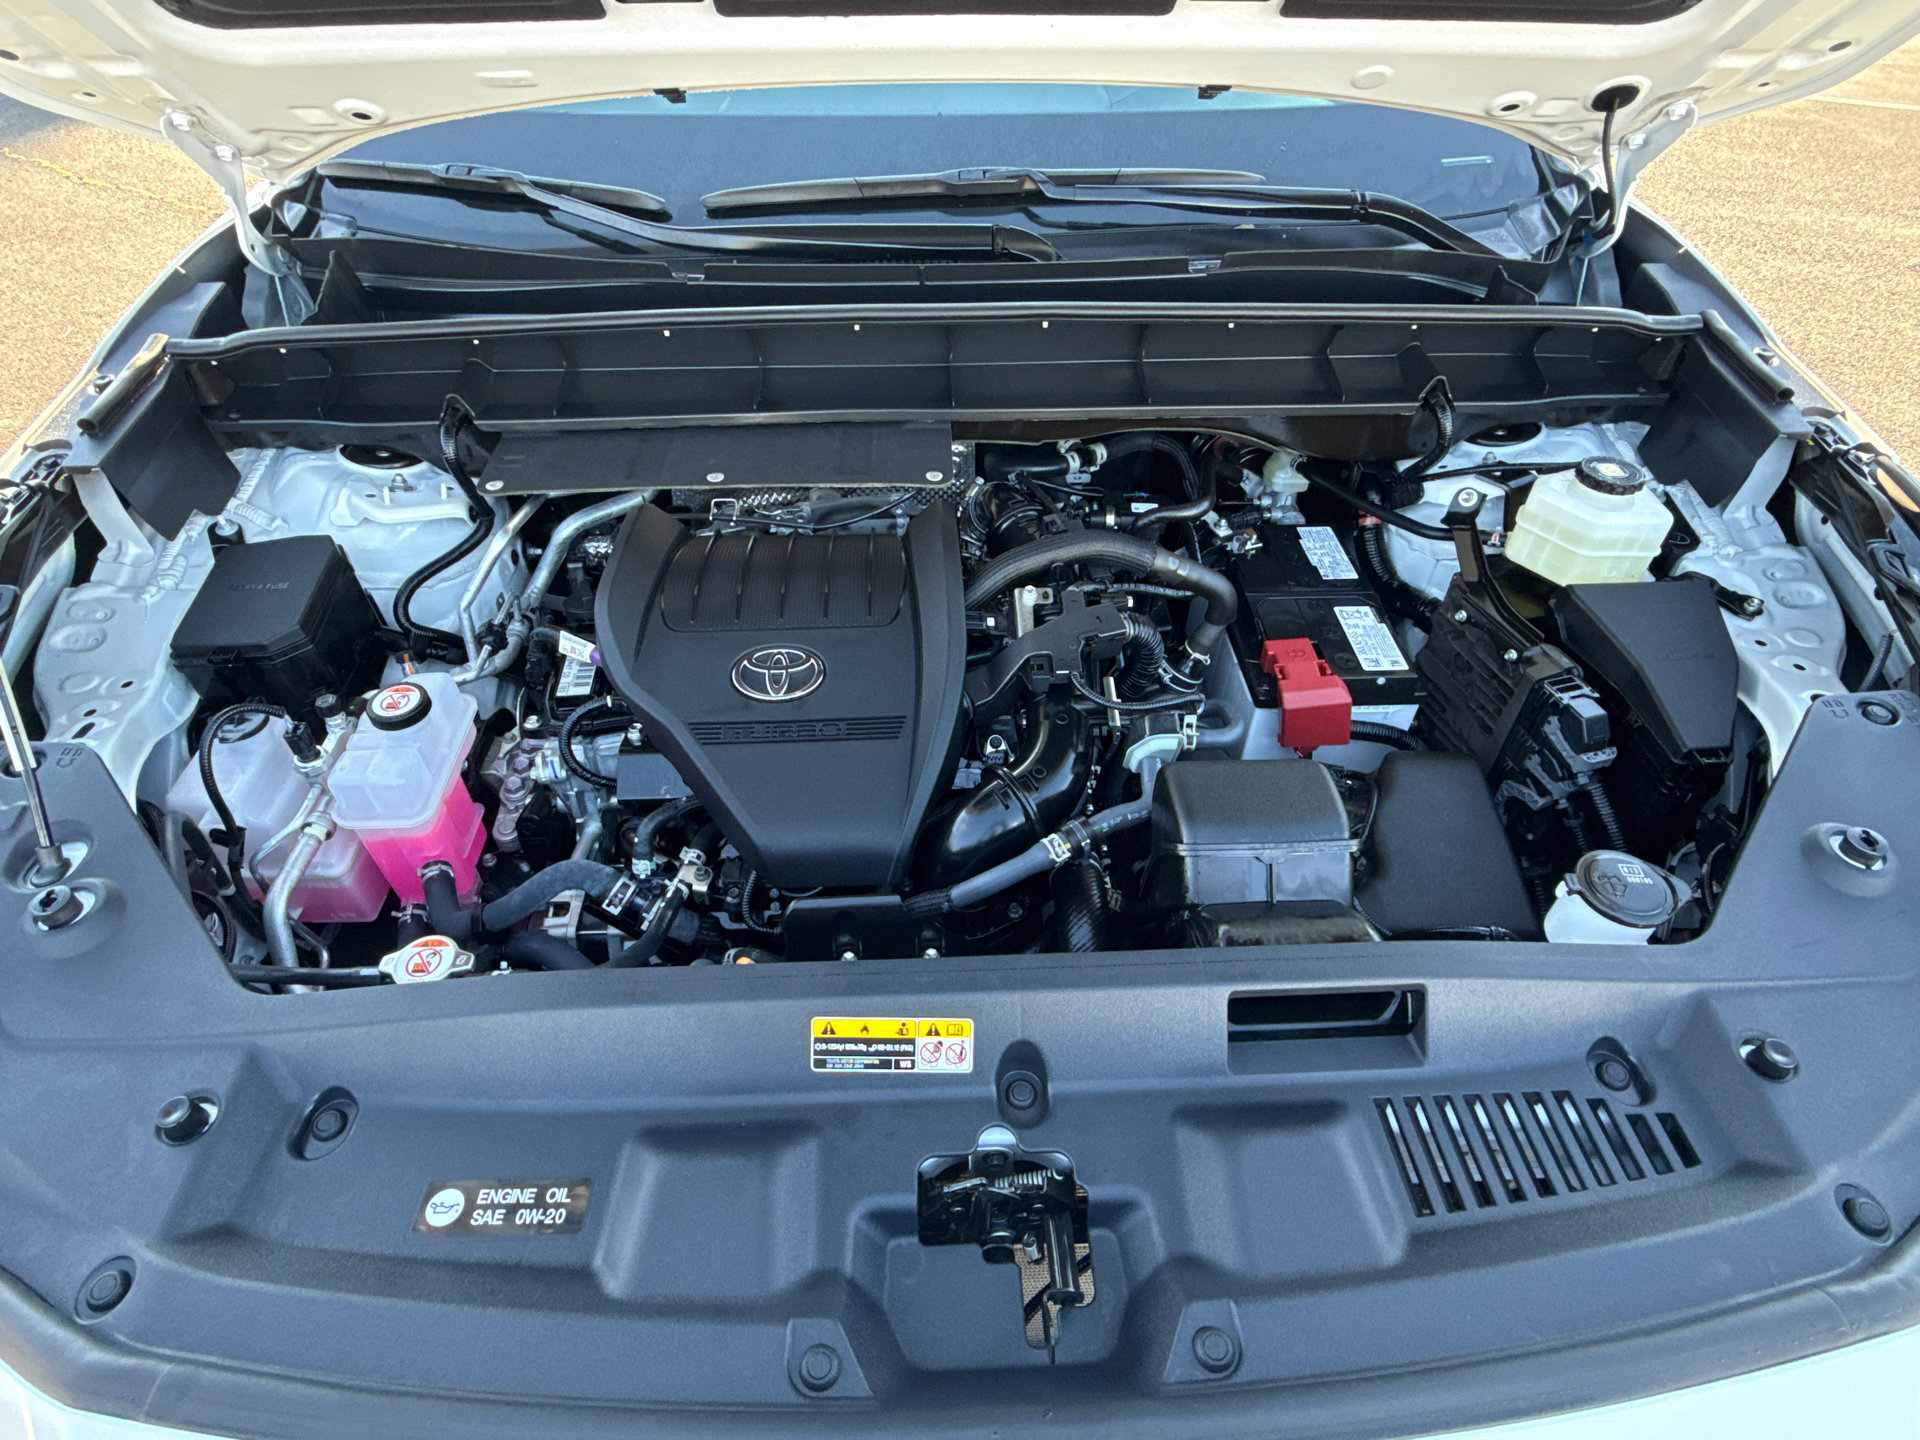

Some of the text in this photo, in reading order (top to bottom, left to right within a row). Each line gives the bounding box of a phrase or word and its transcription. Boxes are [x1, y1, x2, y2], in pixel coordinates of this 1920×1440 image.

[476, 1187, 572, 1205] ENGINE OIL
[470, 1208, 566, 1226] SAE 0W-20
